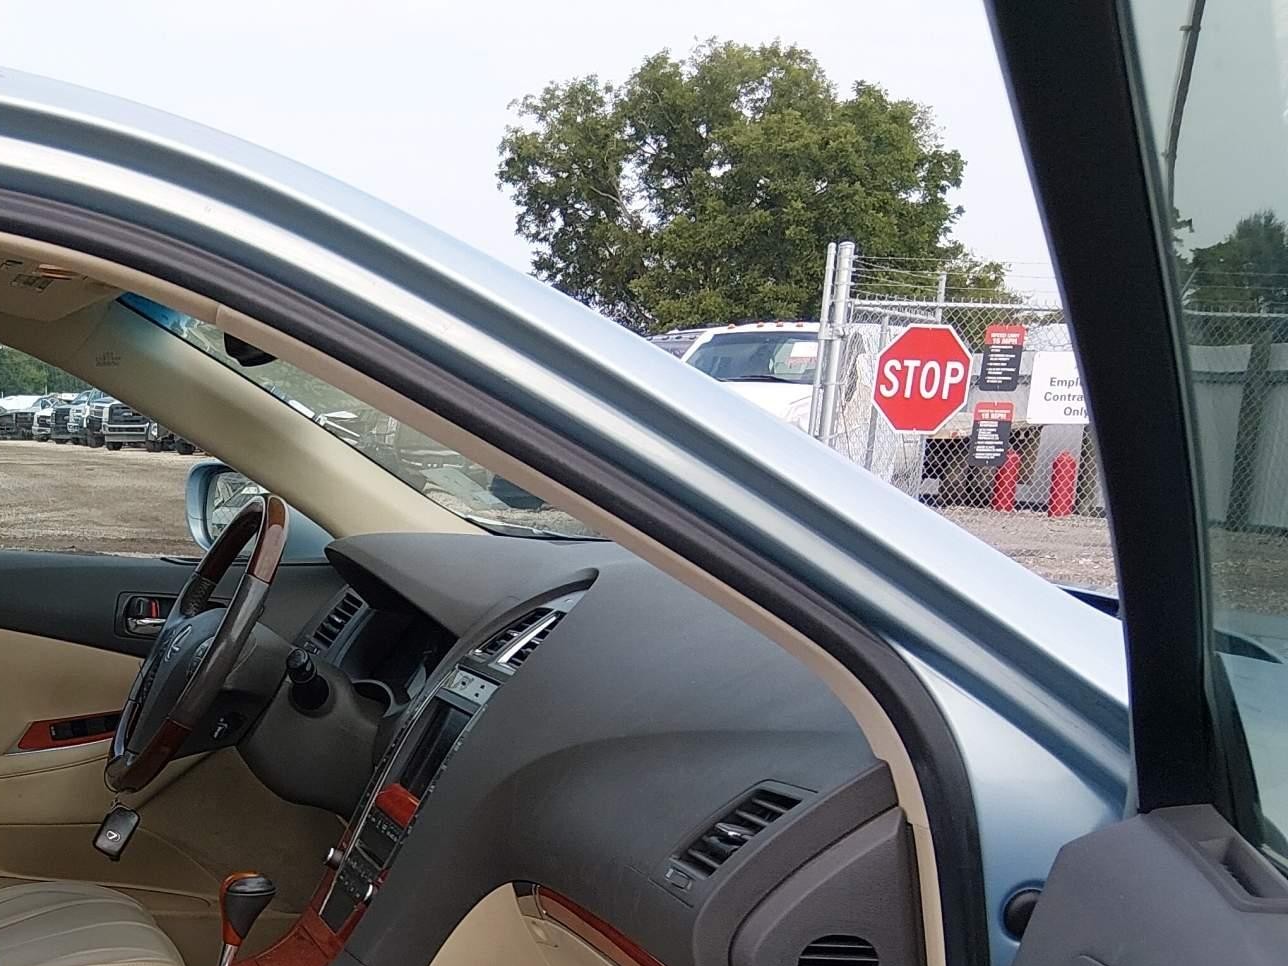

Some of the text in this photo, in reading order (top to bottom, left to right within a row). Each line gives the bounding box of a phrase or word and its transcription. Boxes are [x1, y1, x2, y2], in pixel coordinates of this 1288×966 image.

[879, 359, 965, 400] STOP
[1049, 376, 1080, 388] Empl
[1044, 391, 1085, 402] Contra
[1063, 406, 1088, 419] Only
